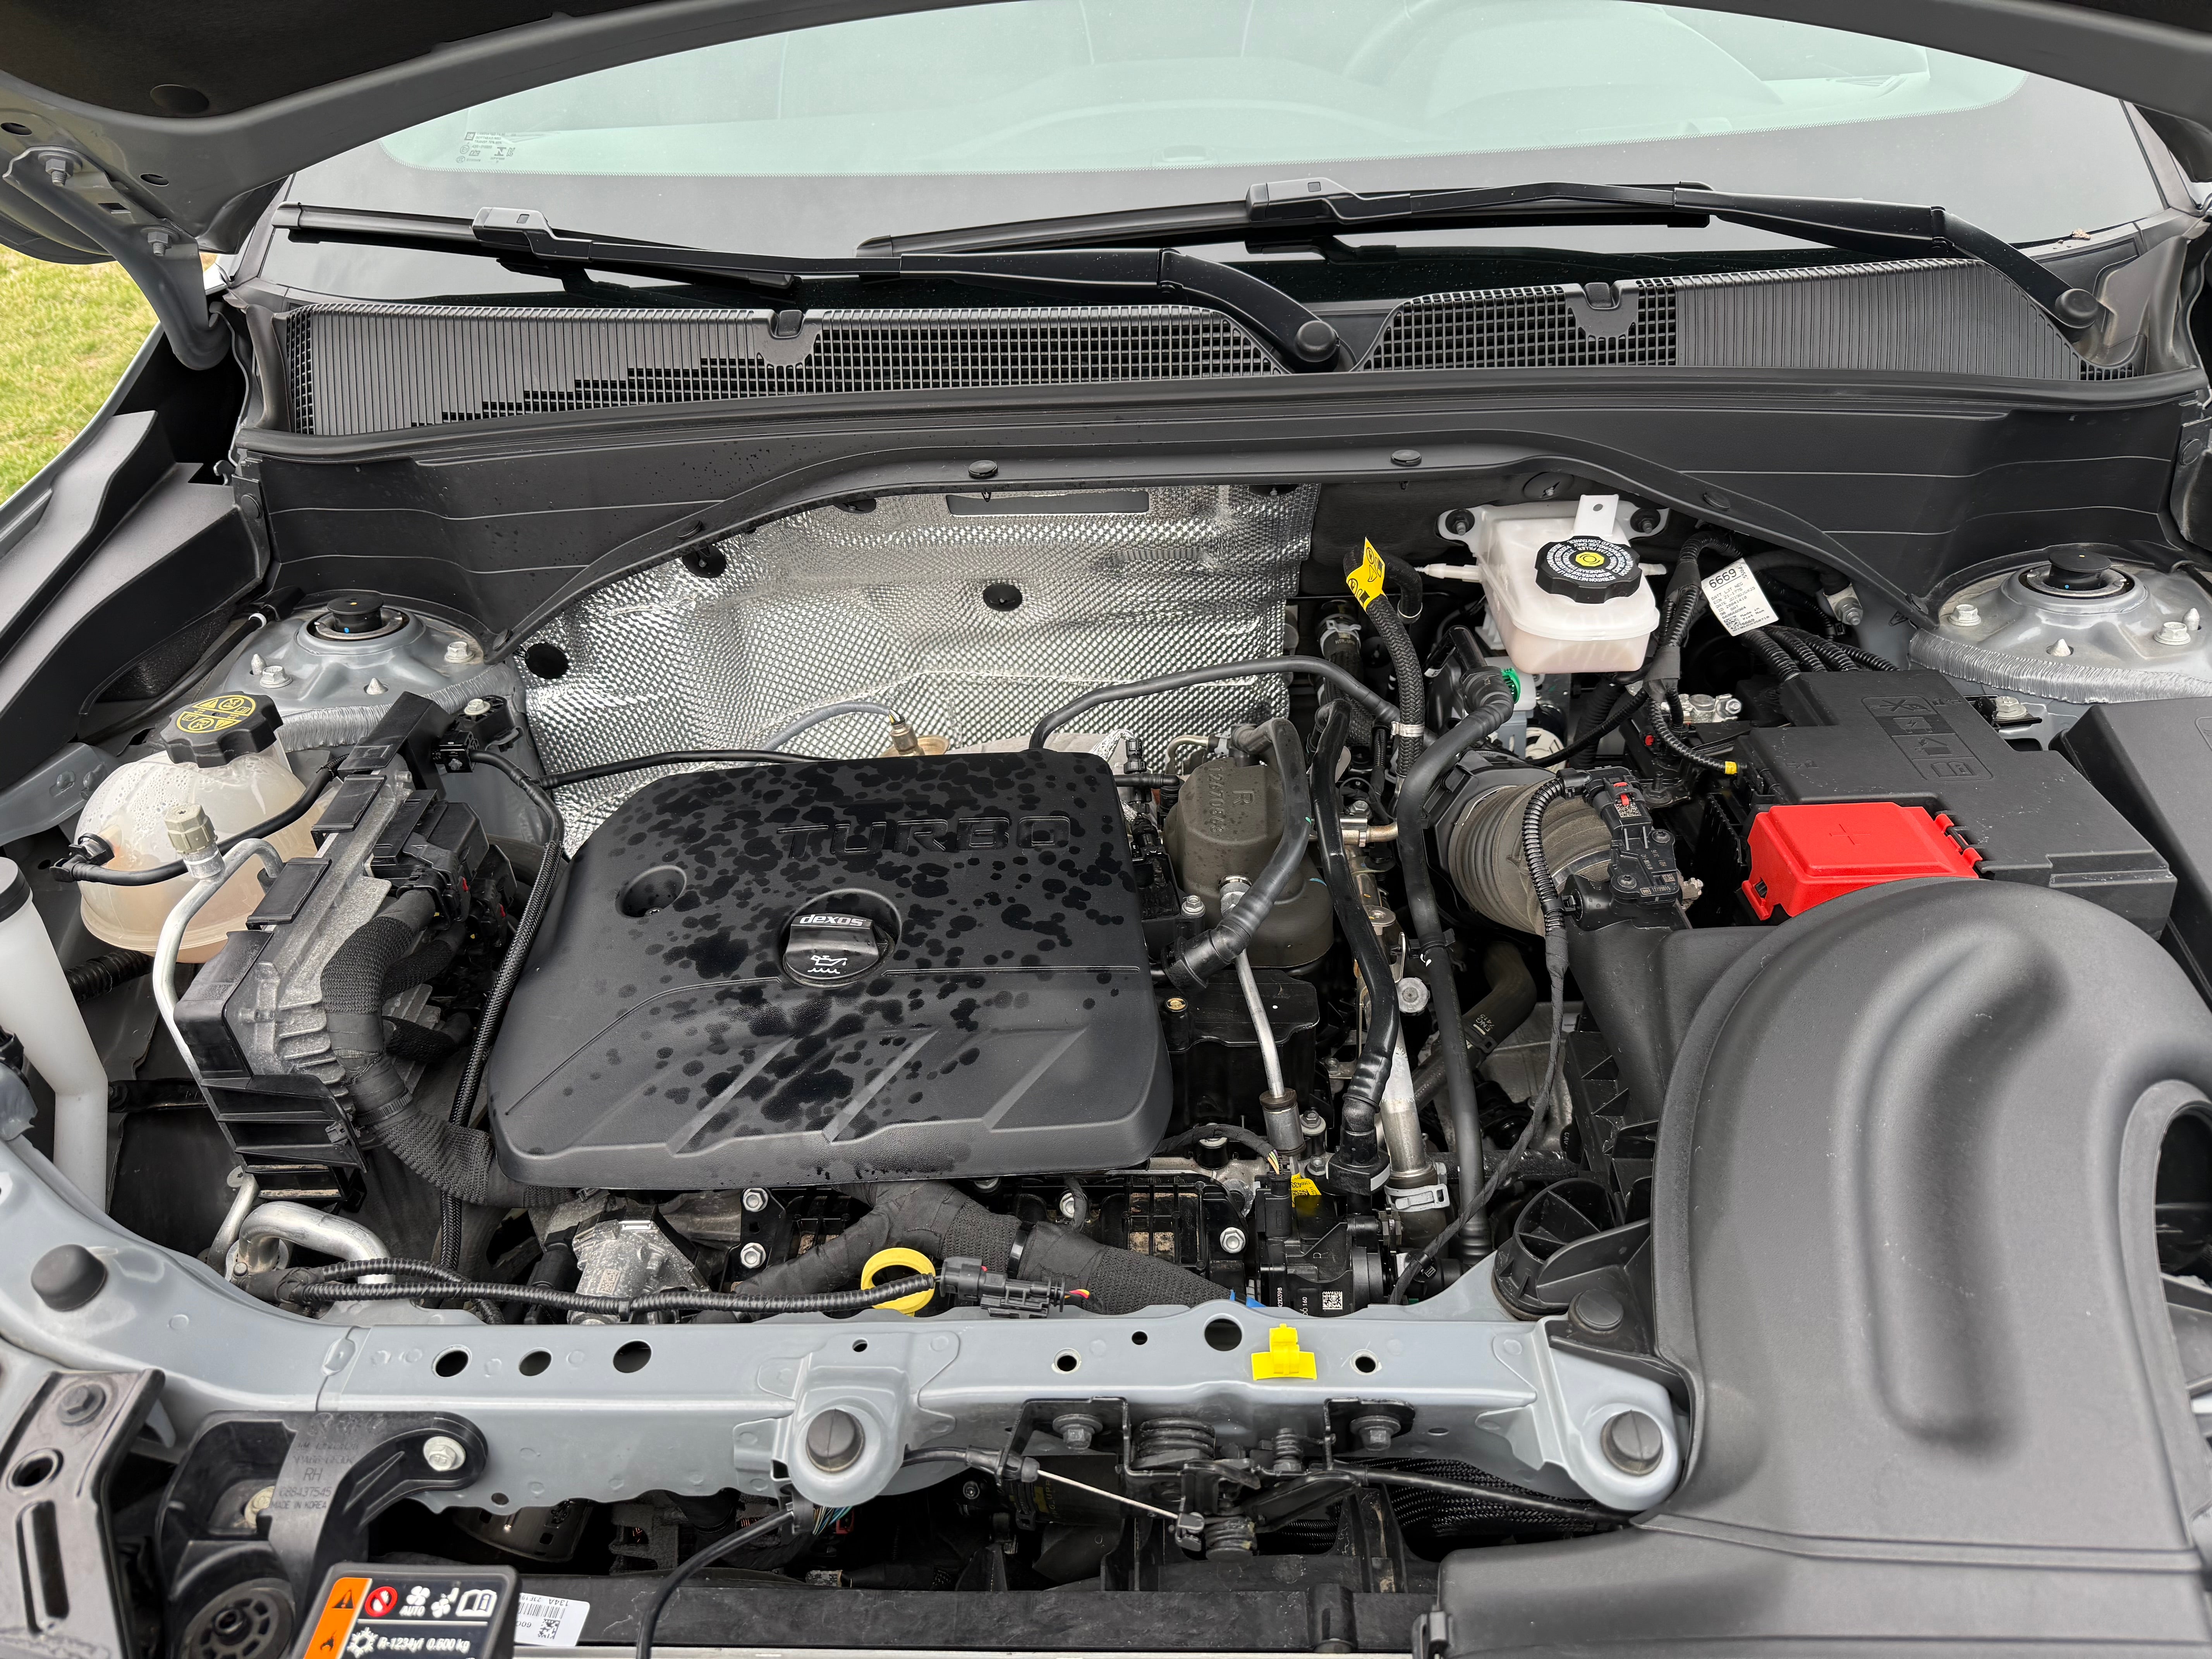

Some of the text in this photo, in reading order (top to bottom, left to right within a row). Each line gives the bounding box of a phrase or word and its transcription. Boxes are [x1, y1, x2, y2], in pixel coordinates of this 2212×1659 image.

[1709, 568, 1736, 588] 6669
[1232, 790, 1254, 805] R
[777, 815, 1070, 859] TURBO
[1476, 1018, 1491, 1032] ENG
[303, 1467, 323, 1481] RH
[549, 1598, 569, 1606] 134A
[399, 1605, 425, 1617] AUTO
[377, 1637, 471, 1654] R-1234yf 0.600 kg
